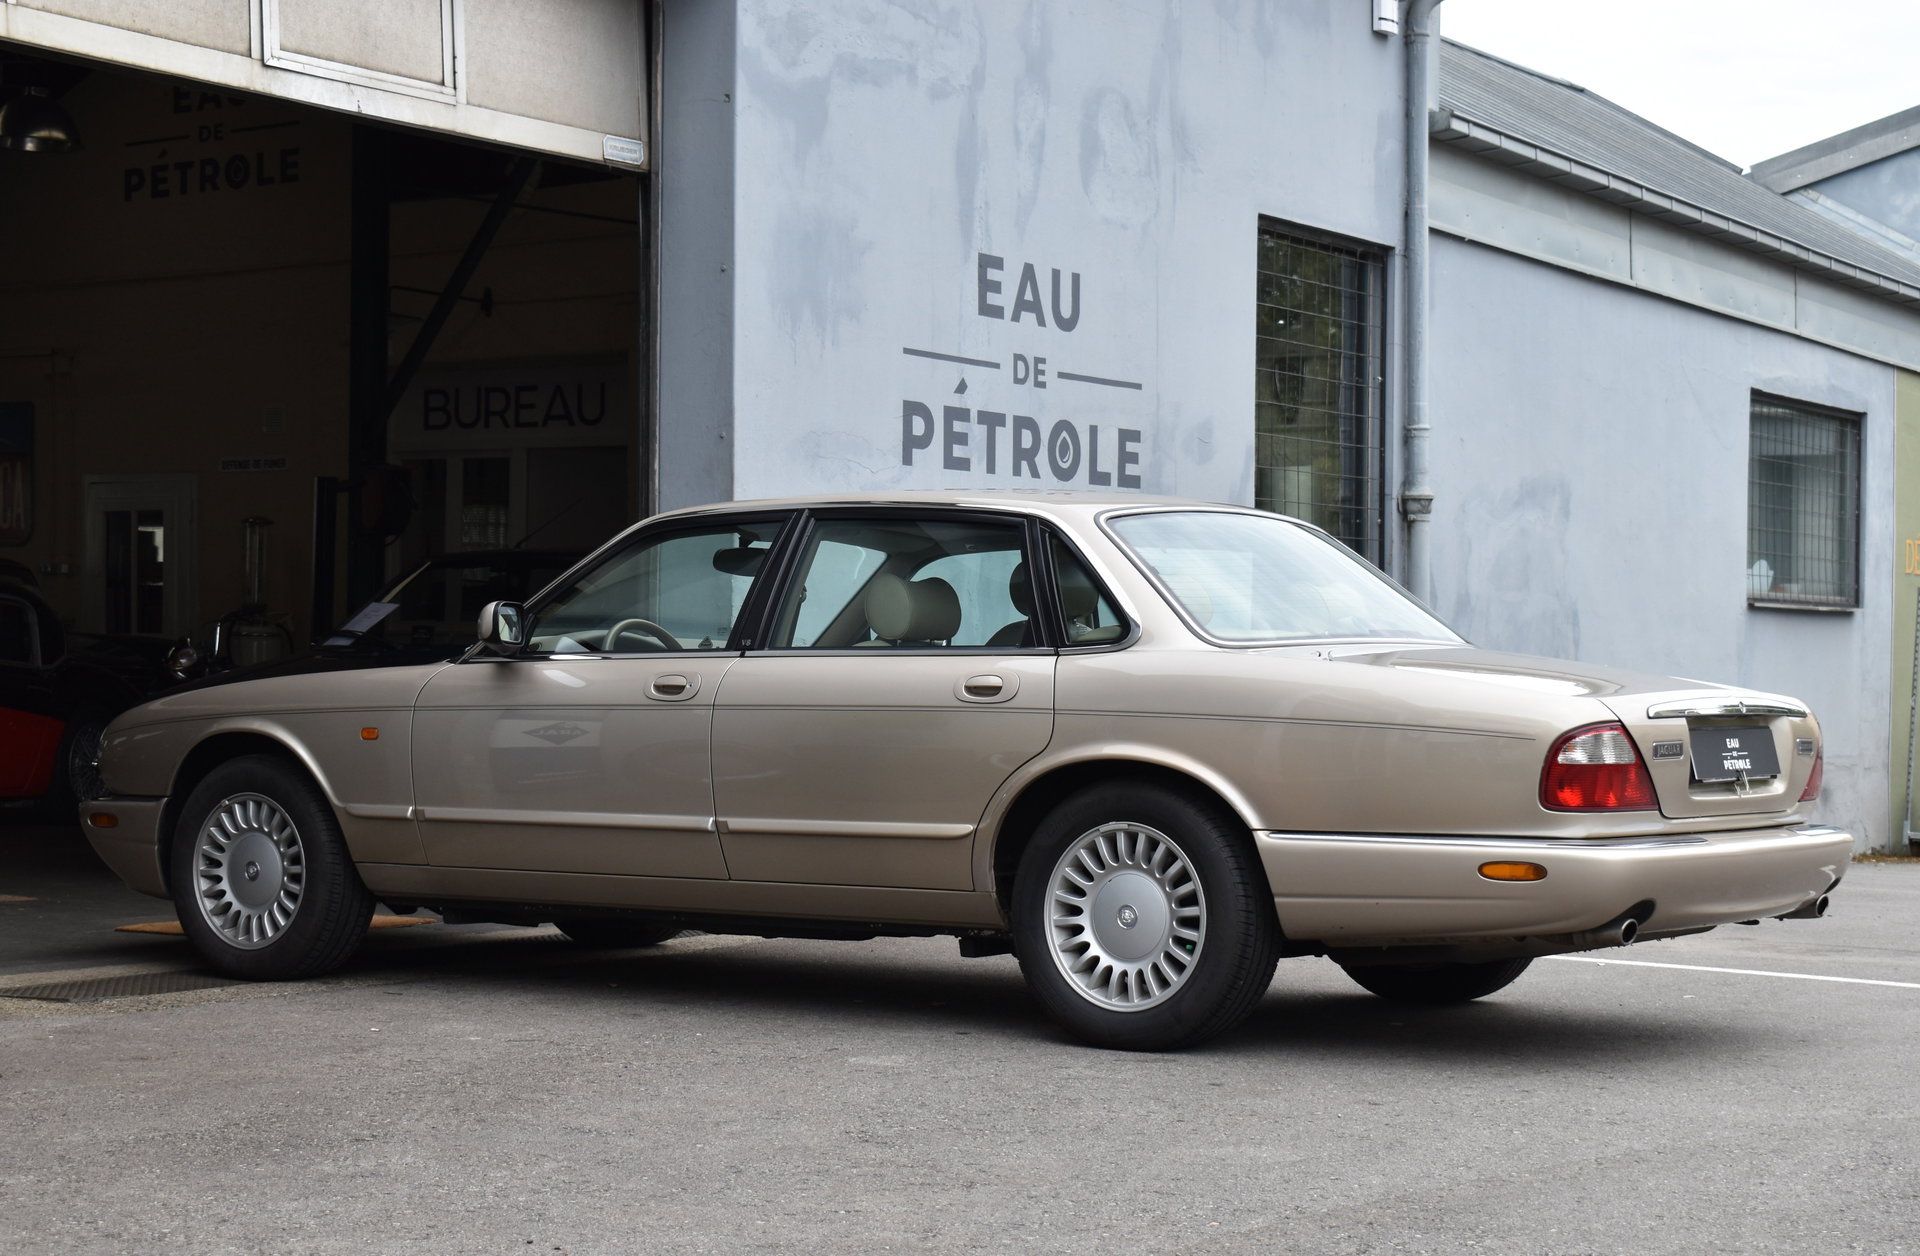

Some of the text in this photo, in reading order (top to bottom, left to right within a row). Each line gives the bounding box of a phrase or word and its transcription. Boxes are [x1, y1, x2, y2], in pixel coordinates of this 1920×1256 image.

[173, 86, 245, 114] EA
[198, 124, 224, 142] DE
[124, 148, 299, 201] PÉTROLE
[978, 252, 1080, 332] EAU
[1013, 353, 1046, 389] DE
[424, 382, 605, 431] BUREAU
[902, 377, 1141, 489] PÉTROLE
[1657, 744, 1681, 757] JAGUAR
[1726, 738, 1740, 748] EAU
